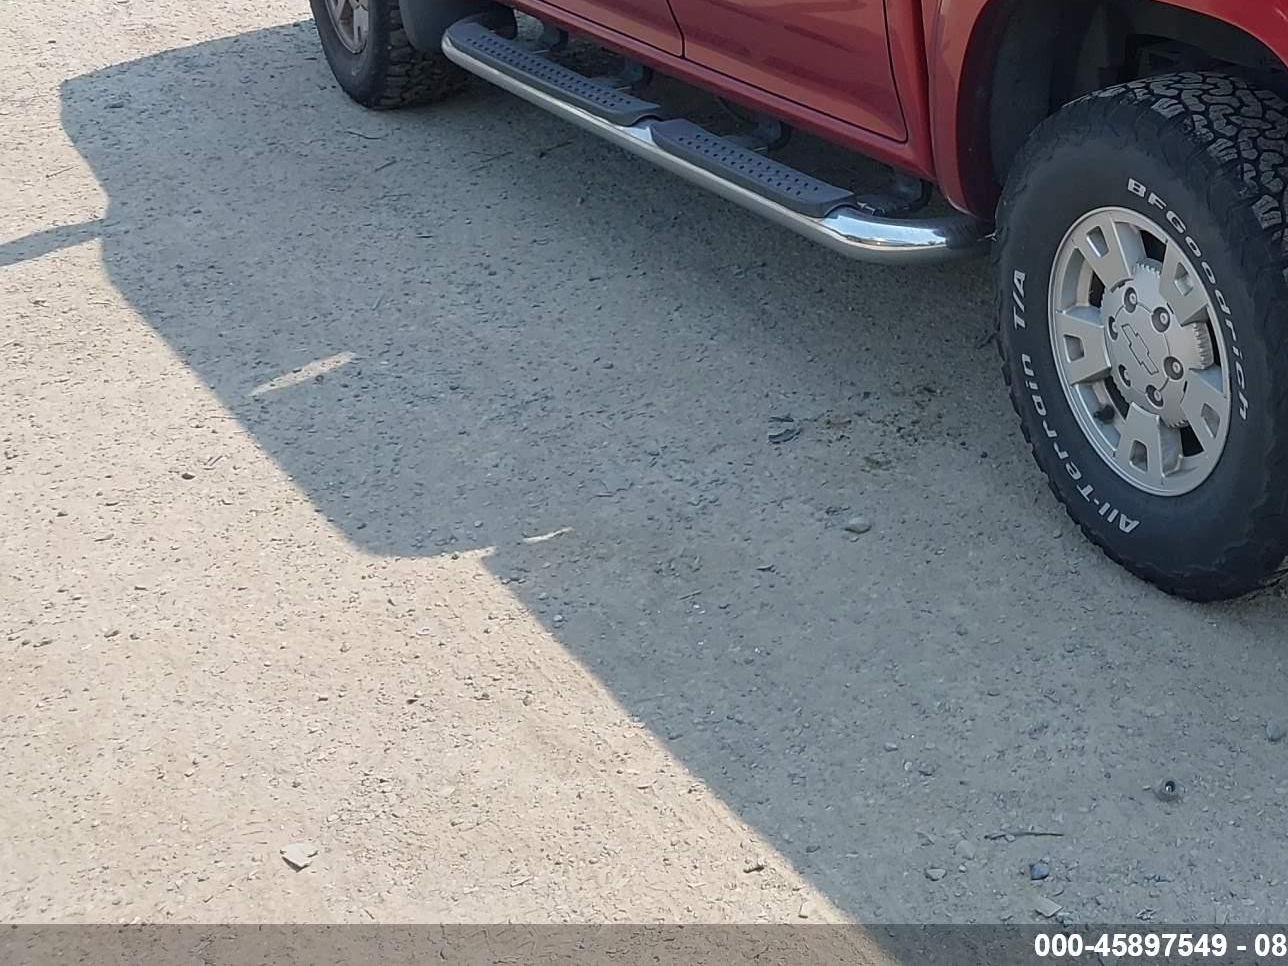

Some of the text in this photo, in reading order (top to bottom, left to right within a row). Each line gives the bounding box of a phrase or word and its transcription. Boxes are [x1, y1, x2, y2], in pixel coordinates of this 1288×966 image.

[1012, 269, 1140, 534] All-Terrain T/A
[1127, 177, 1249, 421] BFGoodrich
